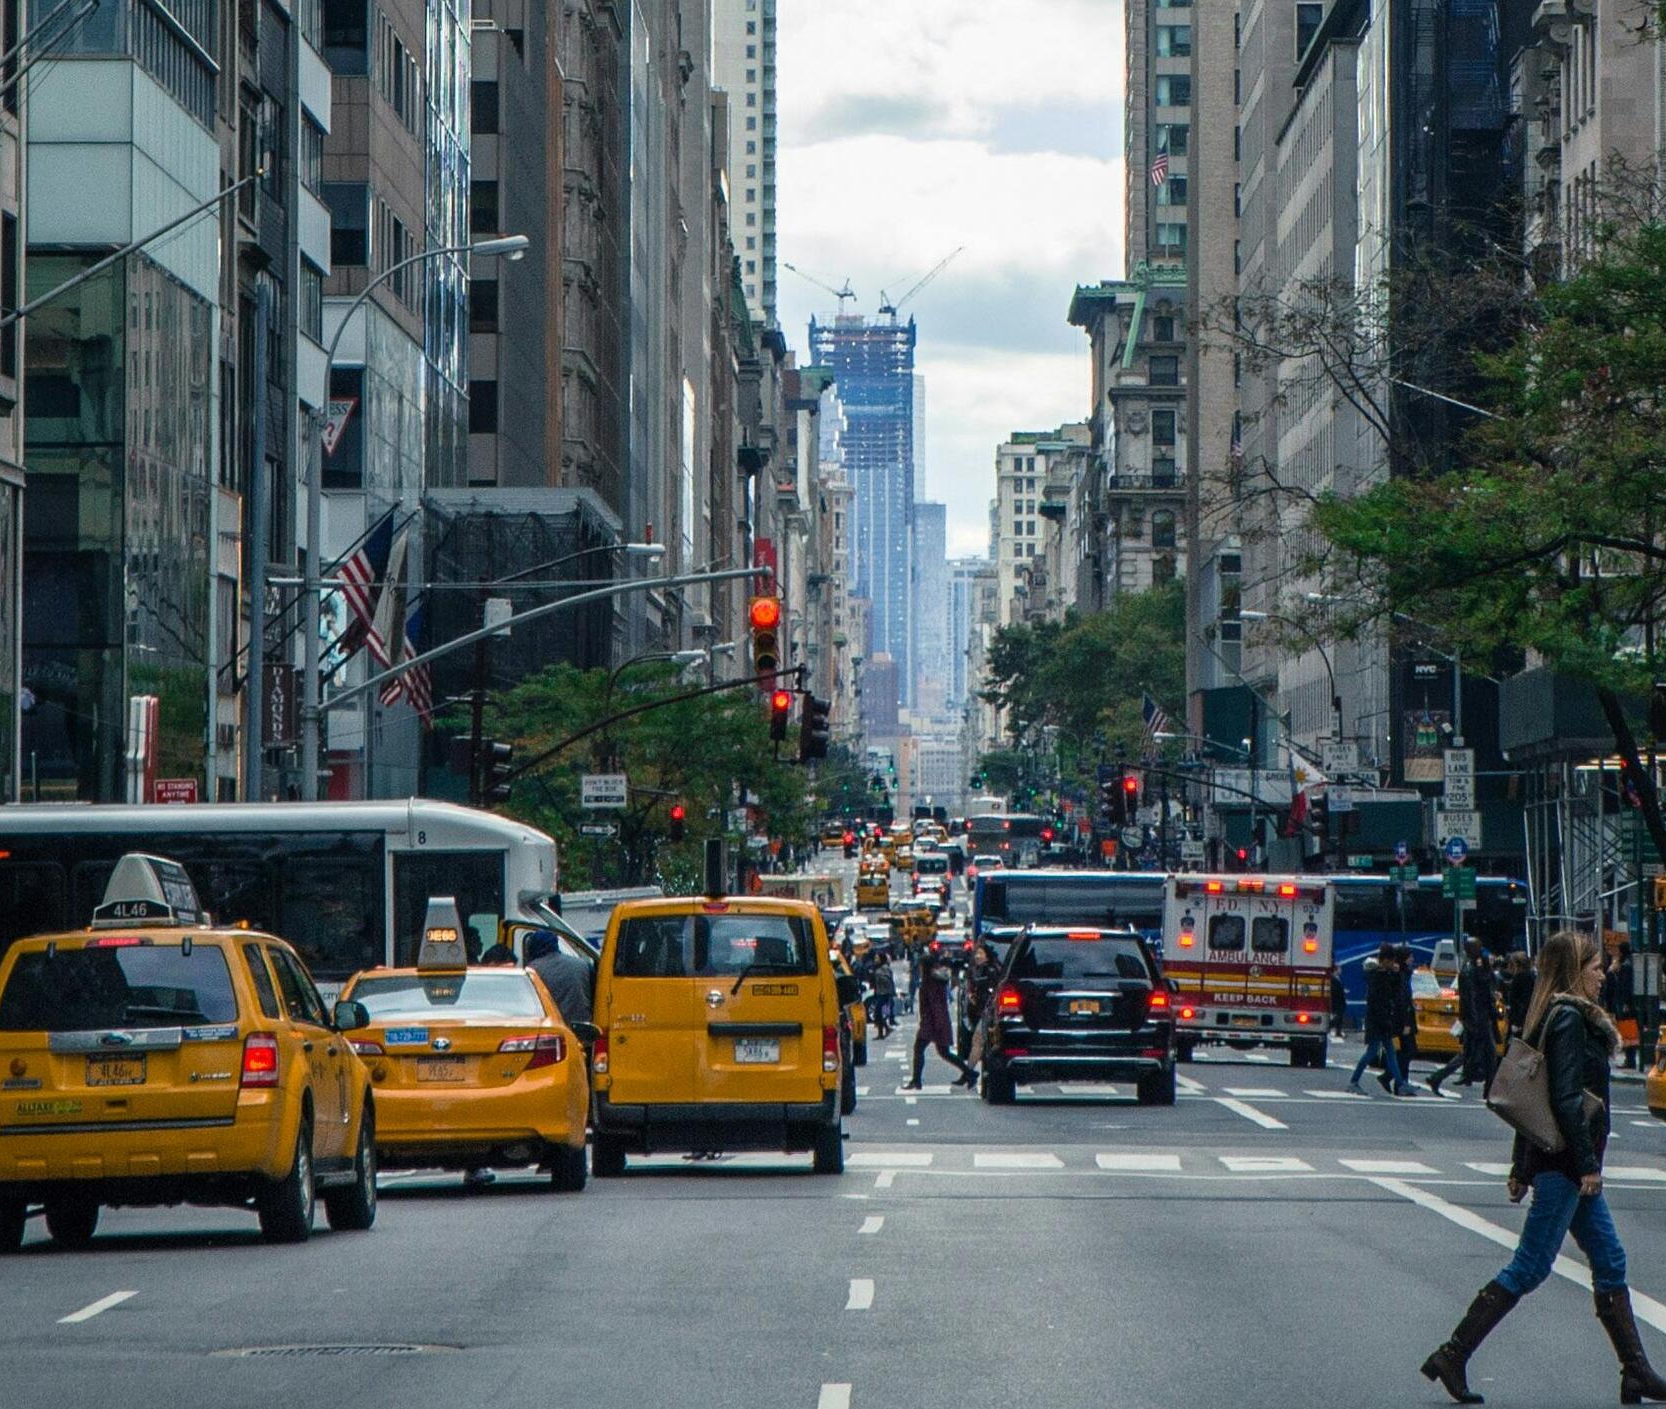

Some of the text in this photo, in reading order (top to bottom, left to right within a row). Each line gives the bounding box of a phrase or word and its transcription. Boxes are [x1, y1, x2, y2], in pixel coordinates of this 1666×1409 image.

[1450, 752, 1468, 762] BUS
[1448, 764, 1470, 774] LANE
[417, 830, 427, 845] 8
[113, 902, 148, 917] 4L46
[1209, 950, 1286, 965] AMBULANCE
[1213, 993, 1278, 1007] KEEP BACK
